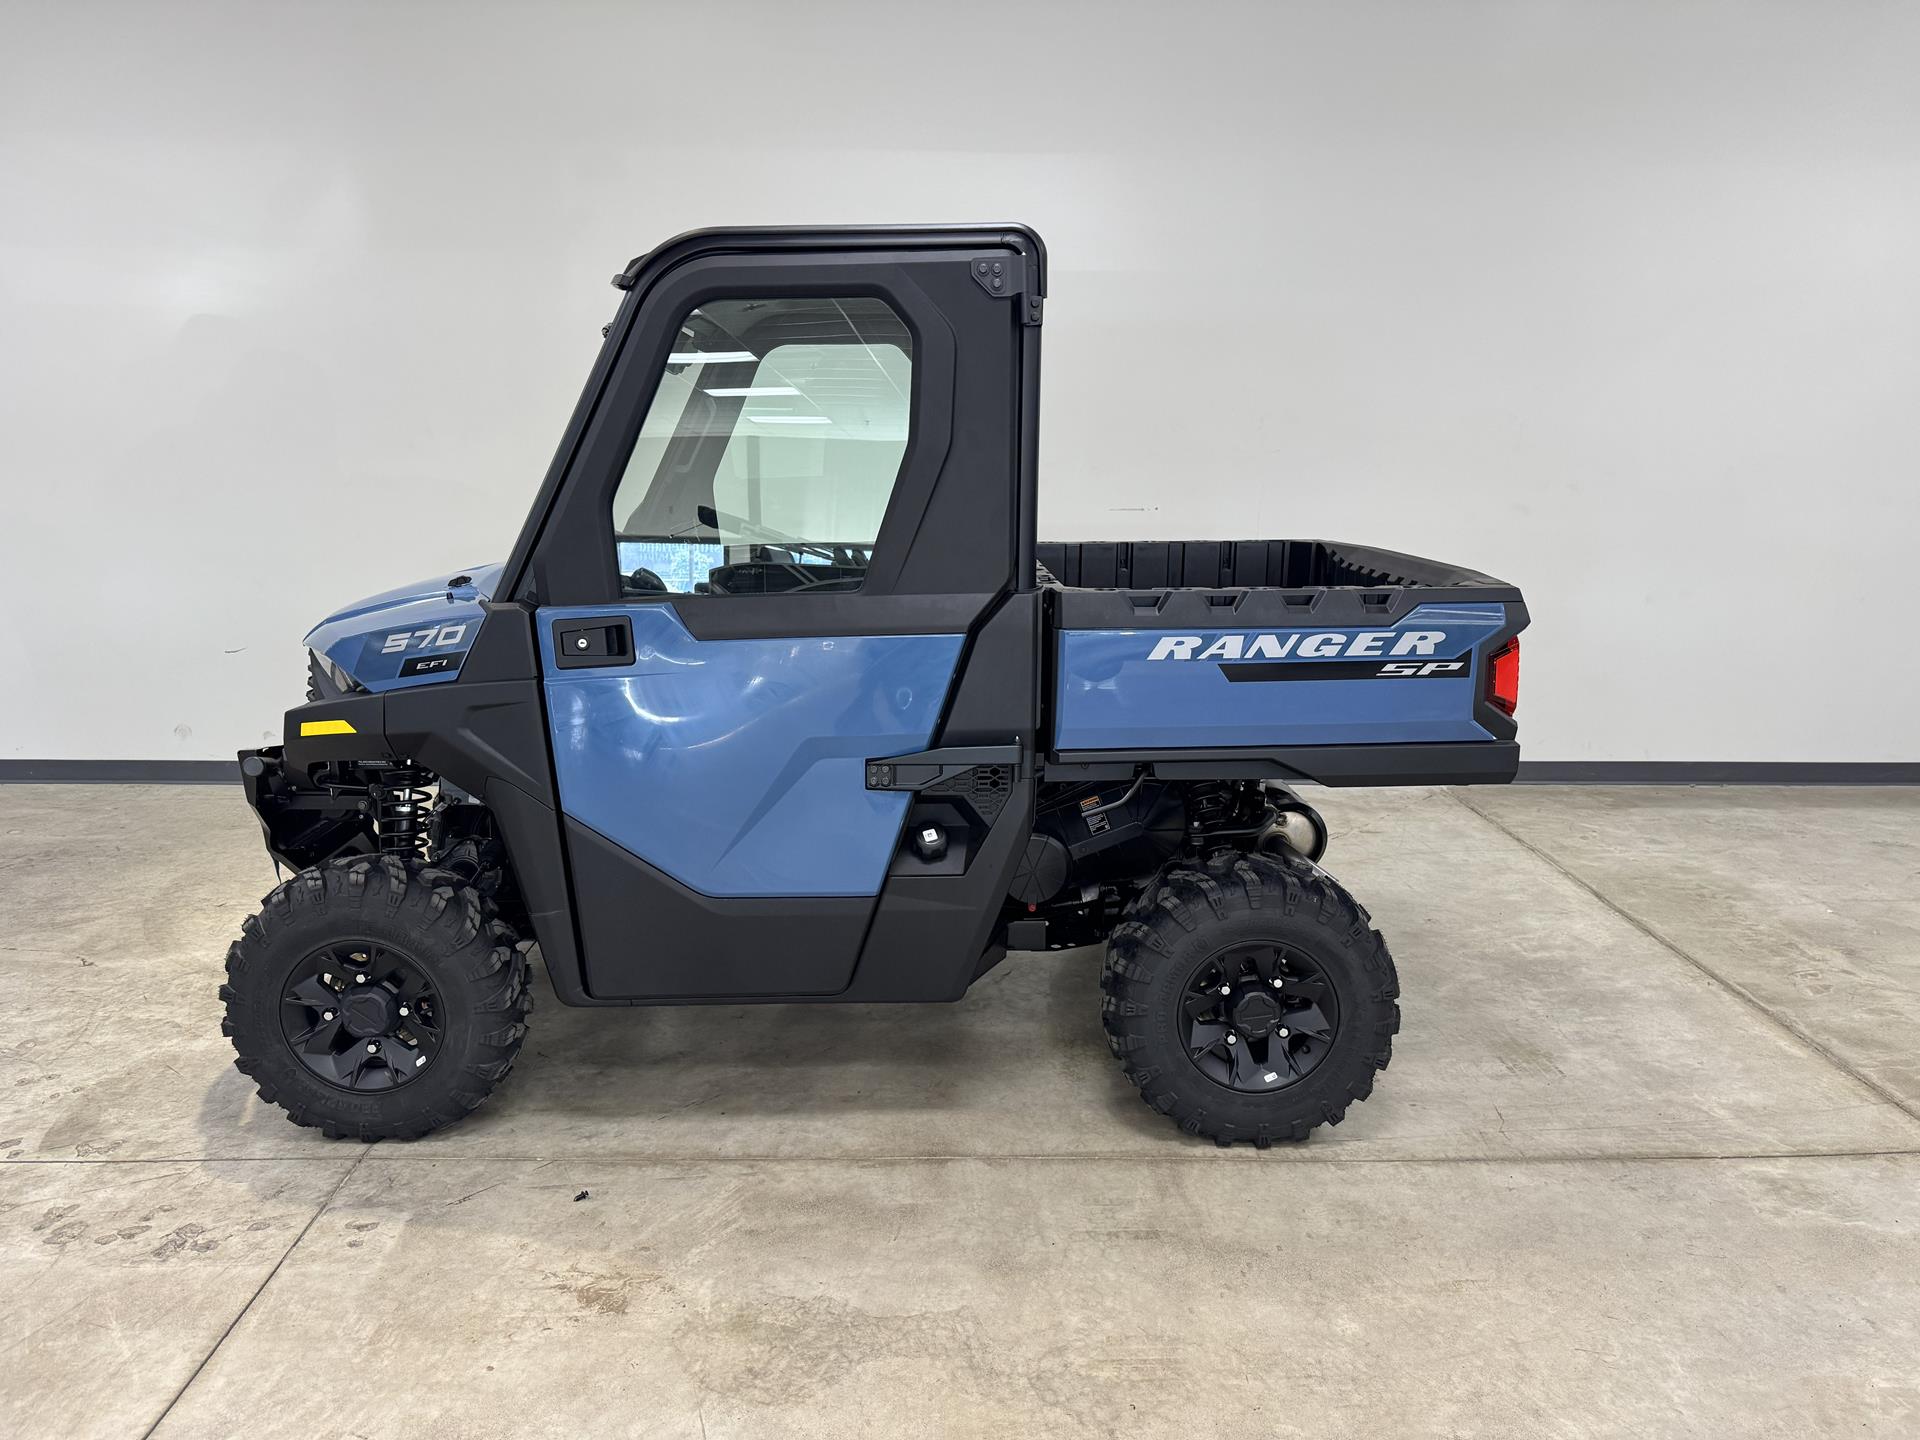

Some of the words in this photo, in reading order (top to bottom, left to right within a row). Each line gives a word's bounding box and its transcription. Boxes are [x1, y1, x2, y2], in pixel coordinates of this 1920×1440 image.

[381, 623, 467, 654] 570
[1146, 631, 1446, 661] RANGER
[416, 659, 447, 671] EFI
[1375, 662, 1465, 677] SP
